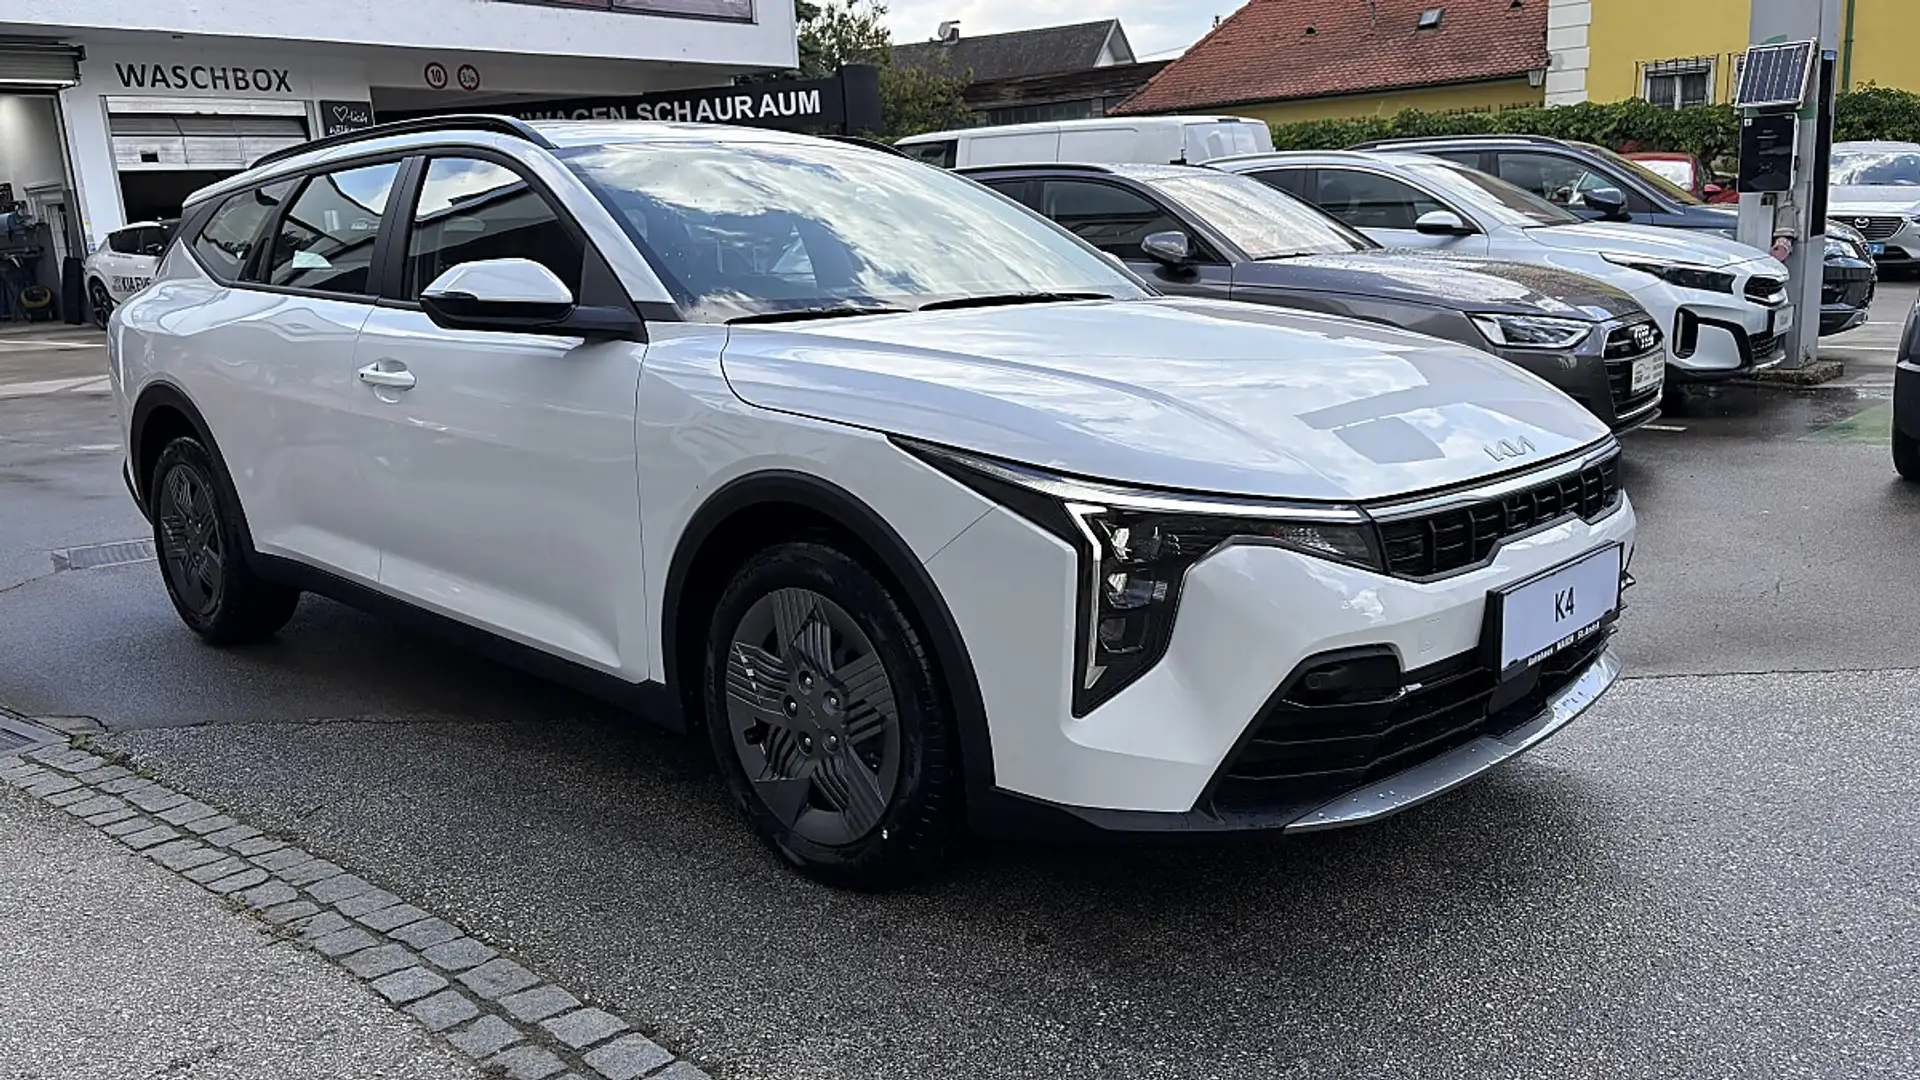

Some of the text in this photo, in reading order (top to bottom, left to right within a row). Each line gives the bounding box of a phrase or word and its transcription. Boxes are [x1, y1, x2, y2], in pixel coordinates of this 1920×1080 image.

[115, 62, 293, 93] WASCHBOX
[430, 68, 443, 83] 10
[1555, 586, 1575, 623] K4
